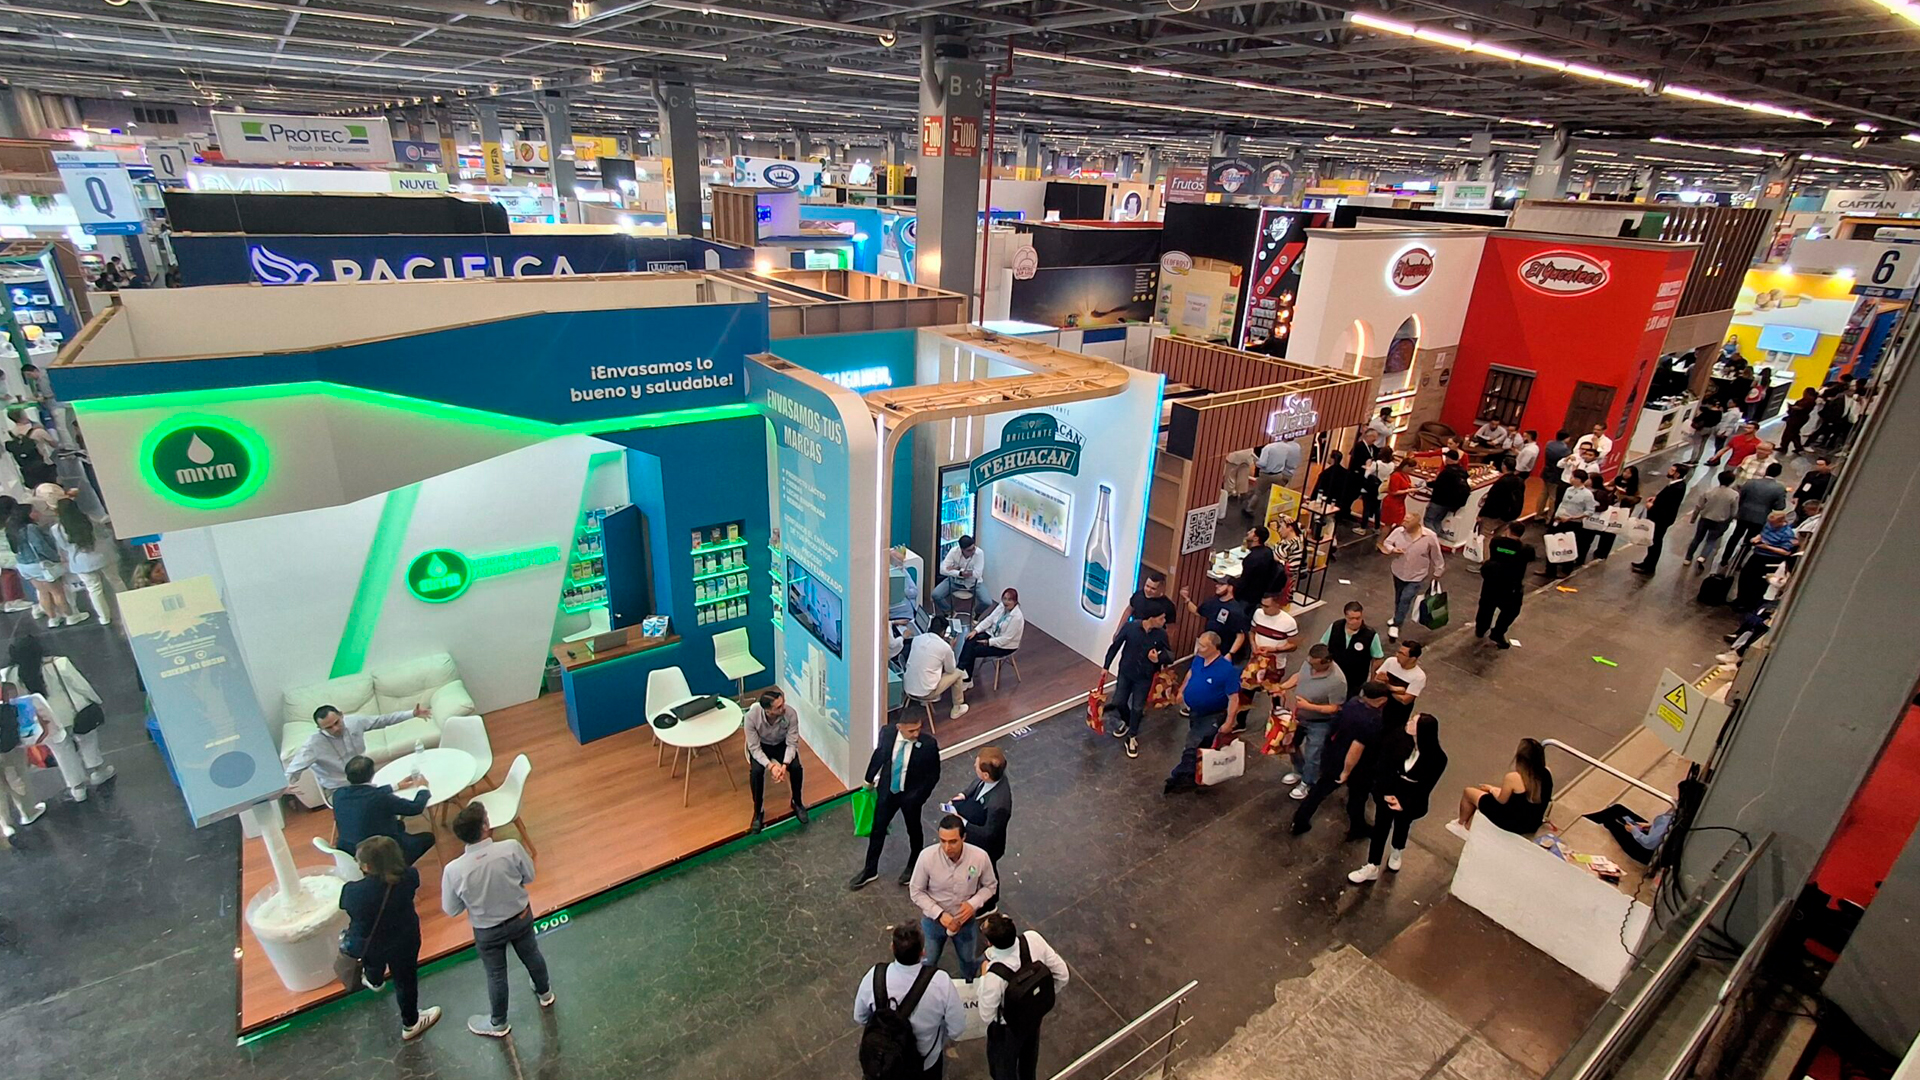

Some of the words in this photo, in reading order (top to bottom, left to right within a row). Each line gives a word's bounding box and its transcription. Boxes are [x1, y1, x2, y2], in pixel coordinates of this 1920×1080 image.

[160, 154, 176, 177] Q
[400, 180, 438, 190] NUVEL
[1171, 178, 1205, 191] Frutos
[85, 176, 116, 219] Q
[1871, 250, 1901, 285] 6
[591, 360, 693, 380] ¡Envasamos
[696, 357, 713, 370] lo
[570, 385, 627, 402] bueno
[631, 384, 642, 399] y
[646, 373, 734, 394] saludable!
[767, 388, 821, 434] ENVASAMOS
[821, 416, 842, 445] TUS
[784, 425, 822, 464] MARCAS
[1006, 428, 1052, 443] BRILLANTE
[533, 914, 569, 934] 1900
